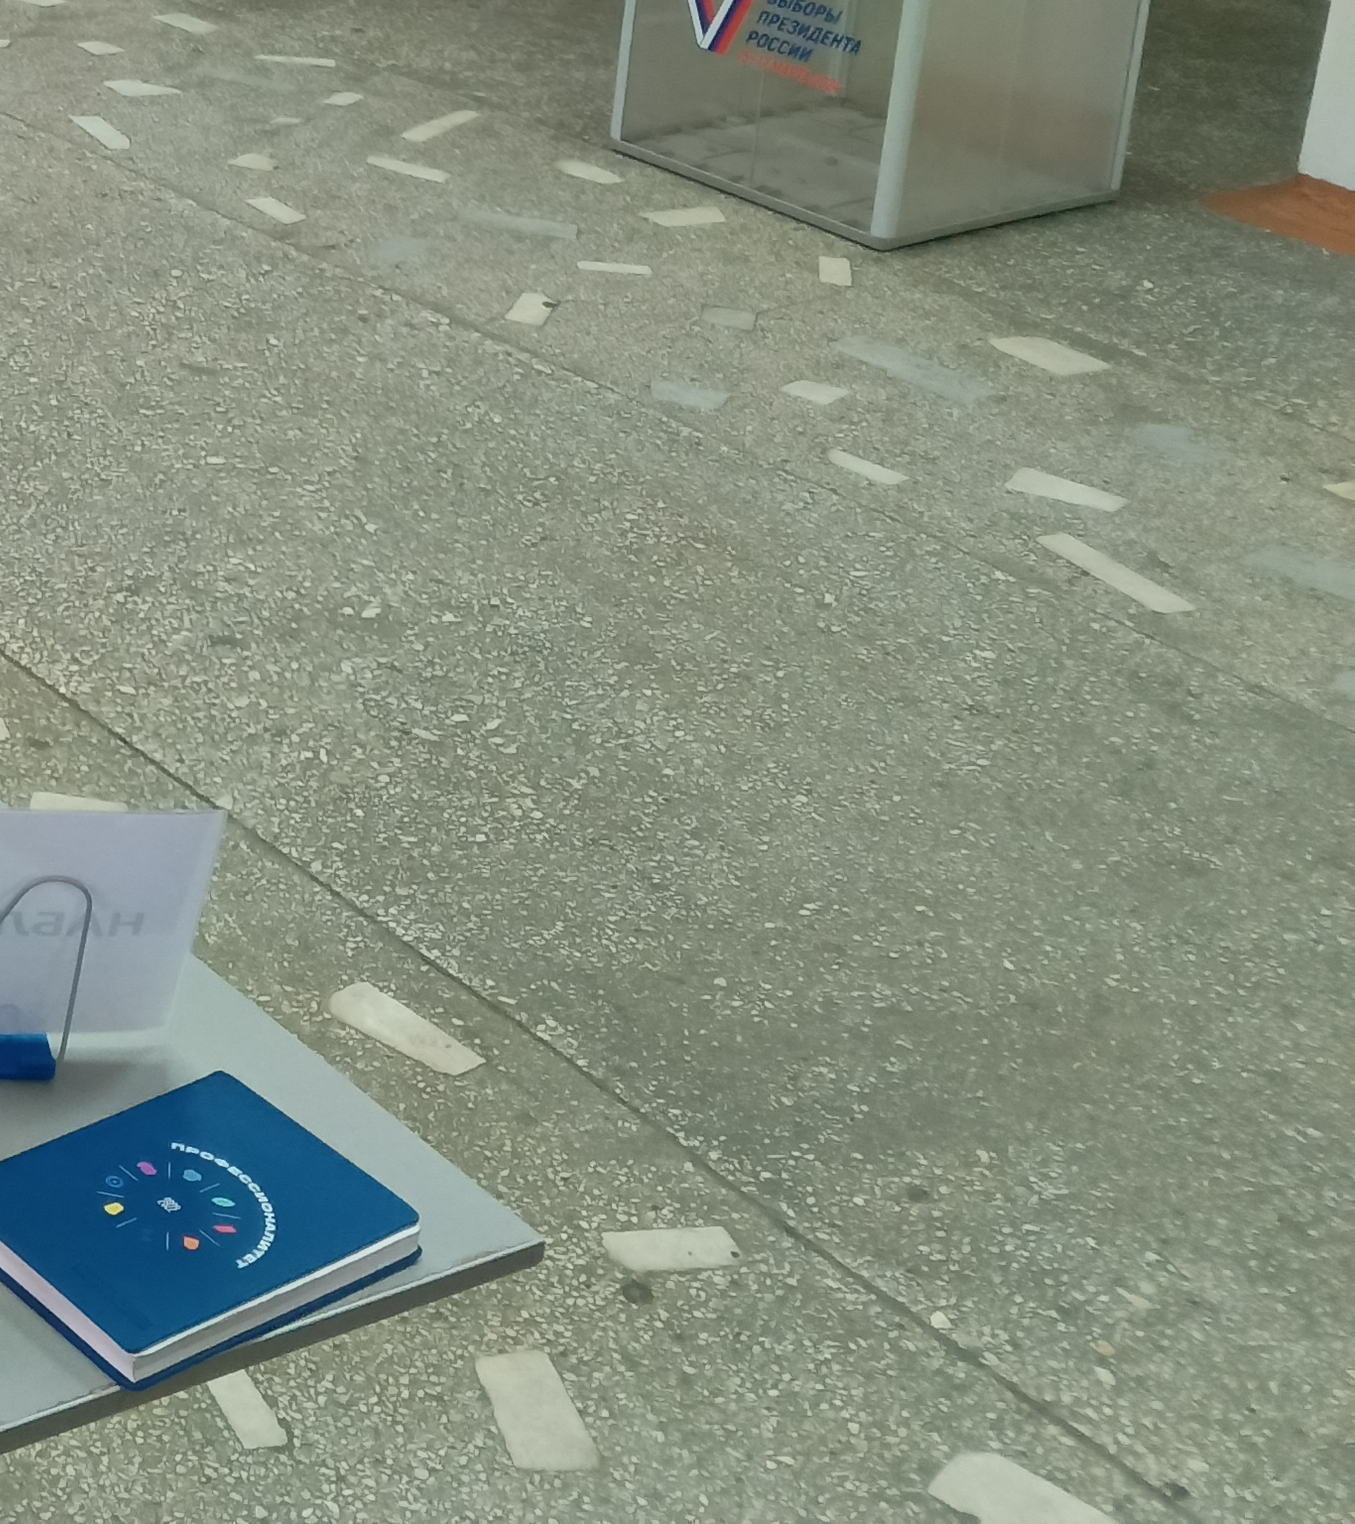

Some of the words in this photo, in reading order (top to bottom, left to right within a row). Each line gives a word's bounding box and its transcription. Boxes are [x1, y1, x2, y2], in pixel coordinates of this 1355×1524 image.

[746, 31, 815, 63] РОССИИ
[756, 11, 862, 55] ПРЕЗИДЕНТА
[171, 1142, 276, 1269] ПРОФЕССИОНАЛИТЕТ
